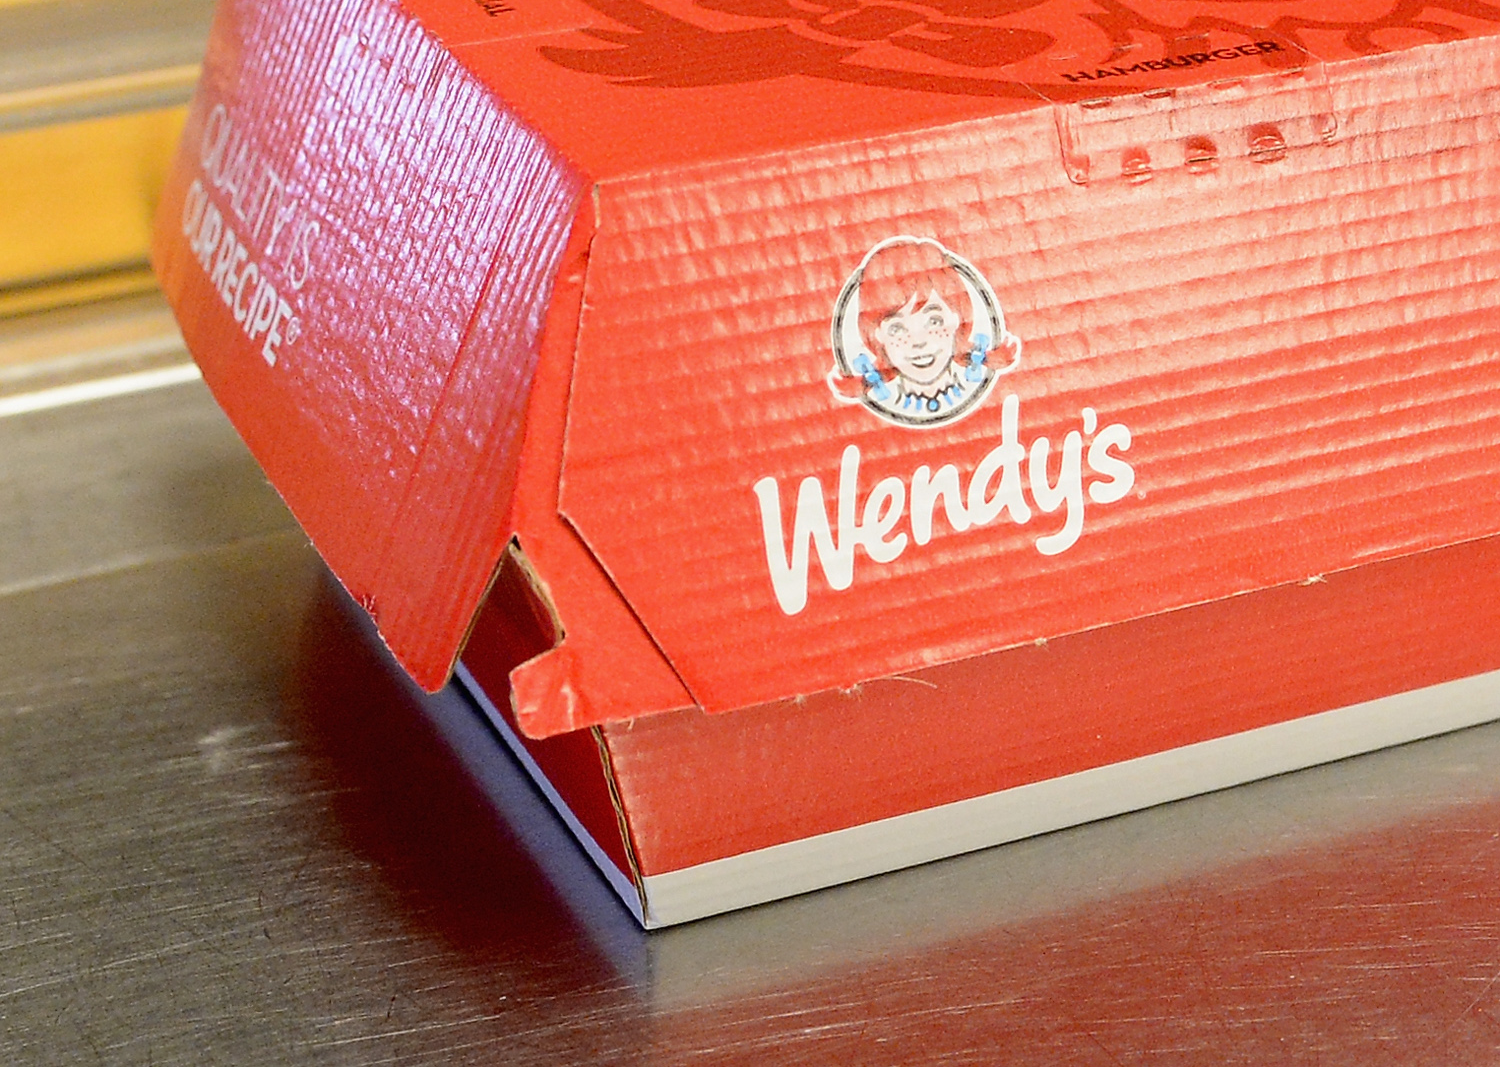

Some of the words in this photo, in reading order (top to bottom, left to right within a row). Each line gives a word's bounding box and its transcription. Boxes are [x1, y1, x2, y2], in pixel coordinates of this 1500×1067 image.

[1060, 39, 1285, 83] HAMBURGER
[181, 179, 223, 273] OUR
[202, 103, 299, 255] QUALITY
[283, 210, 321, 291] IS
[753, 394, 1136, 616] Wendy's
